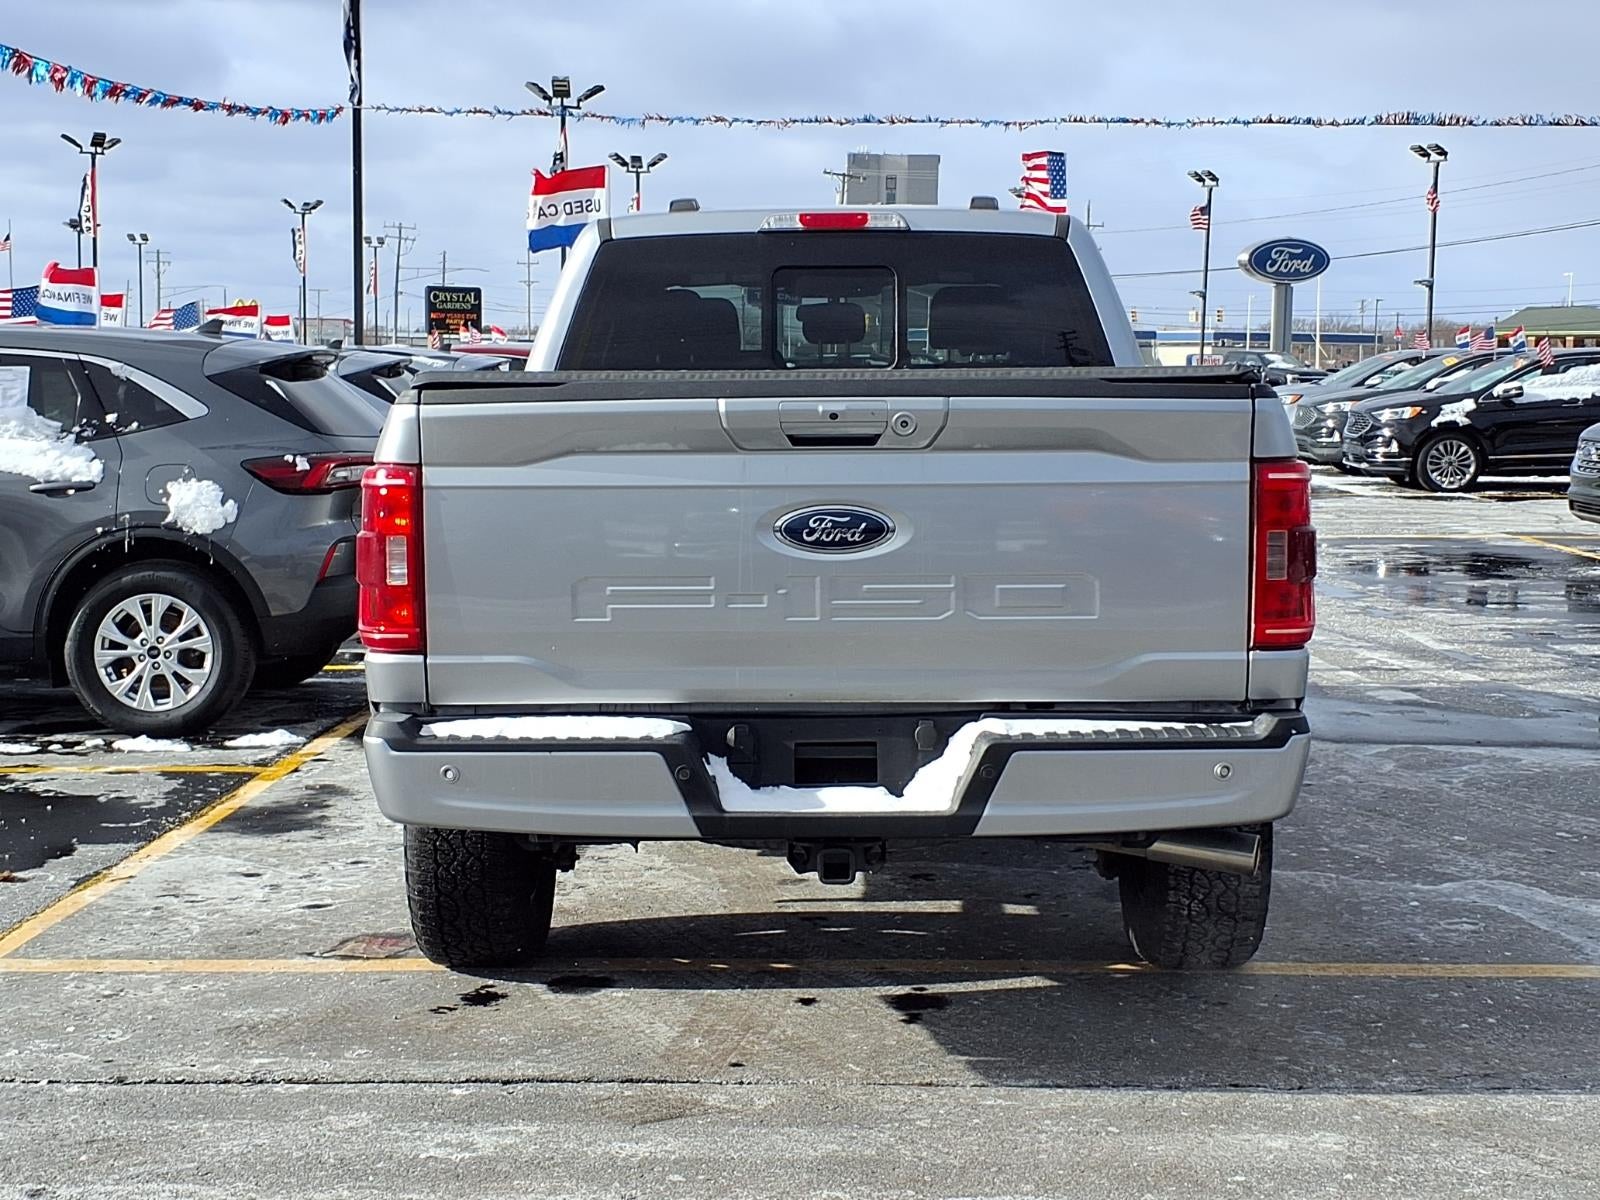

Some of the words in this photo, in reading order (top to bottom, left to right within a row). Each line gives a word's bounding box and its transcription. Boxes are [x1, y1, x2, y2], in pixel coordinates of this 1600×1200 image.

[1266, 246, 1315, 273] Ford
[430, 291, 479, 304] CRYSTAL
[436, 302, 472, 310] GARDENS
[802, 513, 866, 543] Ford
[571, 572, 1100, 622] F-150
